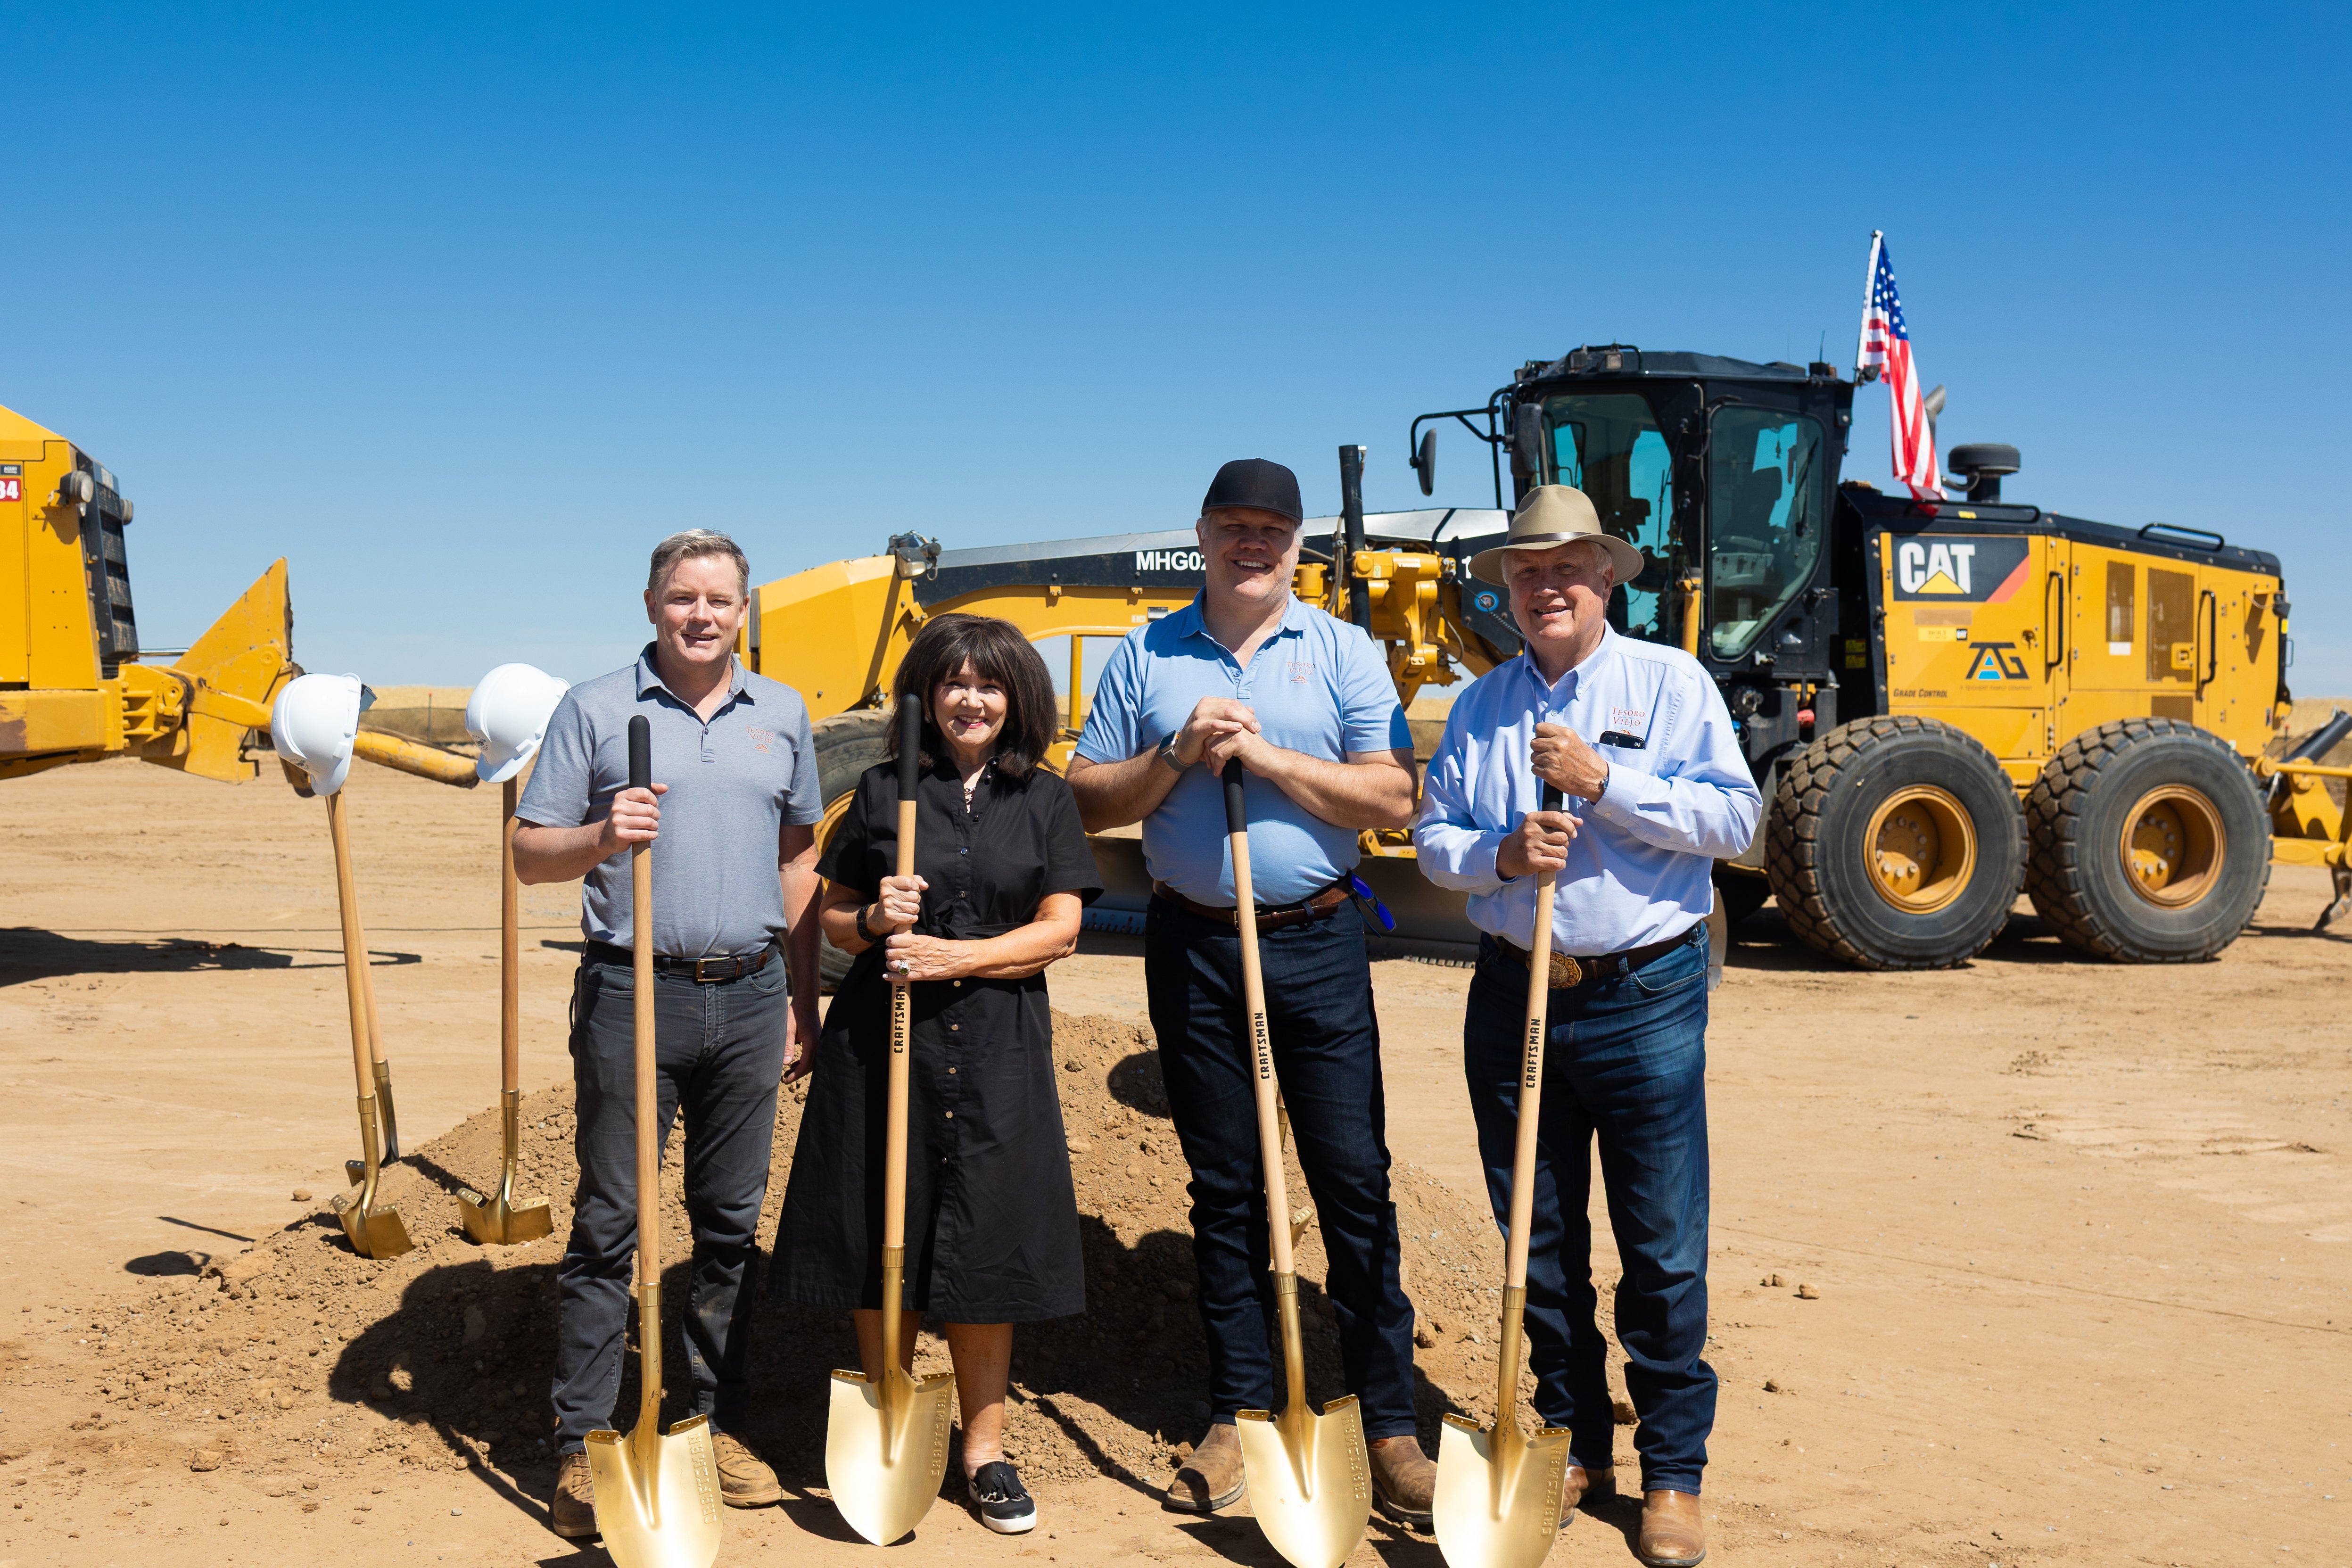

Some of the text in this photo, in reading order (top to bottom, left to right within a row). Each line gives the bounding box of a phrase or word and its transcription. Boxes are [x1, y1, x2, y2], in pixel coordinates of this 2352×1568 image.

[1899, 542, 1975, 594] CAT
[745, 726, 774, 737] TESORO
[1613, 707, 1645, 717] TESORO
[1614, 716, 1641, 727] VIEJO
[750, 734, 772, 743] VIEJO
[894, 985, 905, 1053] CRAFTSMAN
[1254, 1012, 1270, 1080] CRAFTSMAN
[1526, 1018, 1541, 1088] CRAFTSMAN
[930, 1389, 948, 1478] CRAFTSMAN
